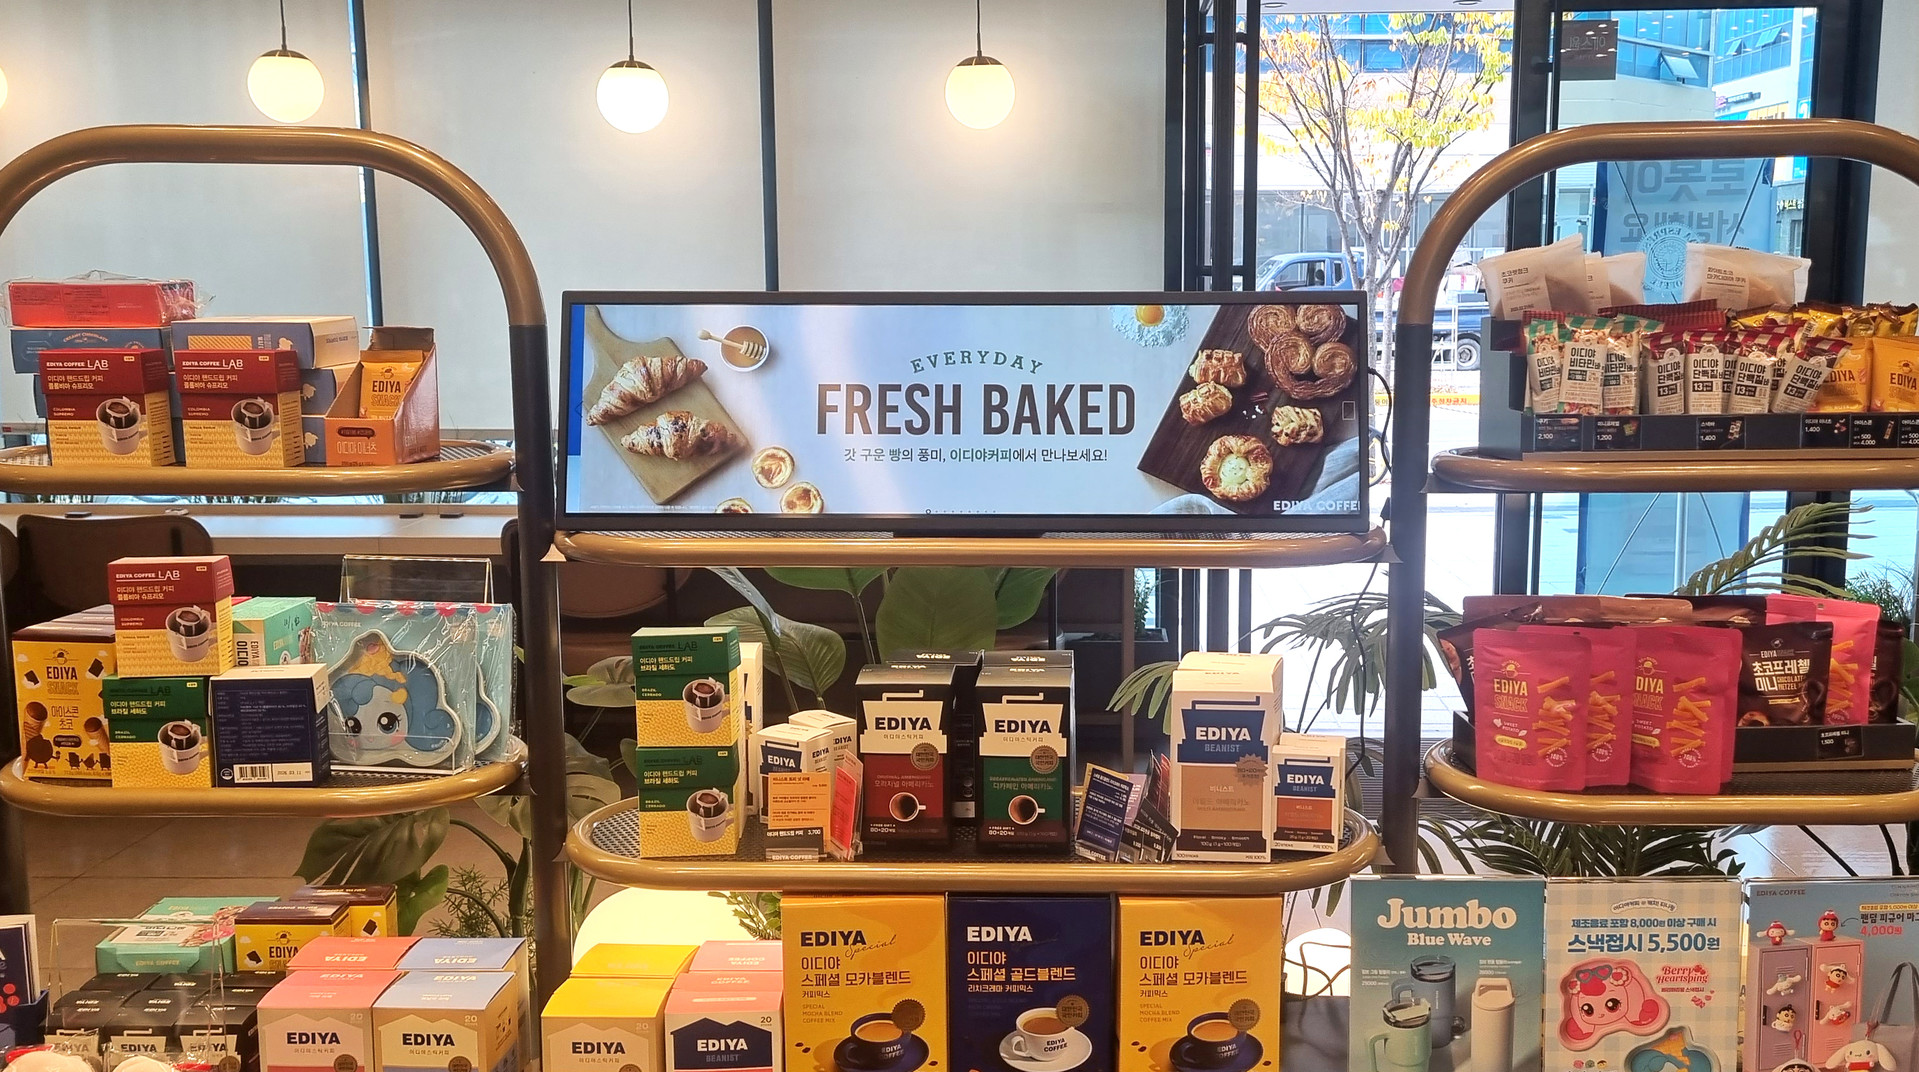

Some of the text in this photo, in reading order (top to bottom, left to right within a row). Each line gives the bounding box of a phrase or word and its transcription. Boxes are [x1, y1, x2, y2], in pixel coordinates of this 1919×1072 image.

[1571, 347, 1596, 357] 이디야
[87, 359, 108, 369] LAB
[222, 359, 244, 368] LAB
[910, 350, 1043, 374] EVERYDAY
[1693, 358, 1719, 369] 이디야
[1740, 362, 1766, 375] 이디야
[1795, 364, 1822, 379] 이디야
[66, 374, 90, 382] 핸드드립
[48, 382, 70, 390] 콜롬비아
[372, 380, 401, 392] EDIYA
[1694, 382, 1703, 390] 13
[1736, 386, 1745, 395] 13
[1786, 385, 1795, 395] 13
[817, 383, 1136, 435] FRESH BAKED
[844, 448, 1108, 462] 갓 구운 빵의 풍미, 이디야커피에서 만나보세요!
[1273, 500, 1360, 511] EDIYA COFFE
[158, 570, 180, 579] LAB
[46, 666, 77, 680] EDIYA
[1752, 658, 1810, 676] 초코프레첼
[1494, 678, 1528, 696] EDIYA
[1636, 676, 1663, 694] DIYA
[1755, 676, 1778, 692] 미니
[1495, 694, 1528, 712] SNACK
[59, 719, 73, 730] 초코
[875, 717, 931, 730] EDIYA
[994, 719, 1051, 733] EDIYA
[1196, 727, 1251, 741] EDIYA
[1204, 744, 1240, 752] BEANIST
[768, 755, 795, 768] EDIYA
[1683, 754, 1696, 762] 100%
[874, 780, 934, 788] 오리지널 아메리카노
[1287, 774, 1324, 784] EDIYA
[1612, 900, 1640, 911] 이디야커피
[1660, 902, 1676, 912] 티니핑
[1377, 898, 1517, 929] Jumbo
[1860, 913, 1877, 923] 랜덤
[1880, 913, 1904, 923] 피규어
[1571, 917, 1717, 928] 제조음료 포함 8,000원 이상 구매 시
[967, 926, 1032, 942] EDIYA
[1861, 925, 1902, 936] 4,000원
[800, 930, 897, 960] EDIYA Special
[1139, 930, 1235, 960] EDIYA Special
[1408, 932, 1492, 946] Blue Wave
[1567, 933, 1720, 953] 스낵접시 5,500원
[801, 956, 841, 970] 이디야
[967, 951, 1007, 965] 이디야
[1140, 955, 1179, 970] 이디야
[967, 966, 1076, 982] 스페셜 골드블렌드
[1662, 965, 1696, 977] Berry
[801, 970, 911, 987] 스페셜 모카블렌드
[1139, 970, 1248, 986] 스페셜 모카블렌드
[1656, 973, 1709, 984] Heartsping
[802, 990, 831, 998] 커피믹스
[967, 984, 1034, 993] 리치크레마 커피믹스
[1139, 990, 1168, 998] 커피믹스
[464, 1015, 478, 1023] 20
[286, 1032, 341, 1045] EDIYA
[402, 1033, 455, 1047] EDIYA
[1046, 1038, 1065, 1046] EDIYA
[120, 1043, 157, 1053] EDIYA
[571, 1041, 626, 1054] EDIYA
[697, 1038, 748, 1052] EDIYA
[1044, 1043, 1067, 1052] COFFEE
[705, 1054, 739, 1062] BEANIST
